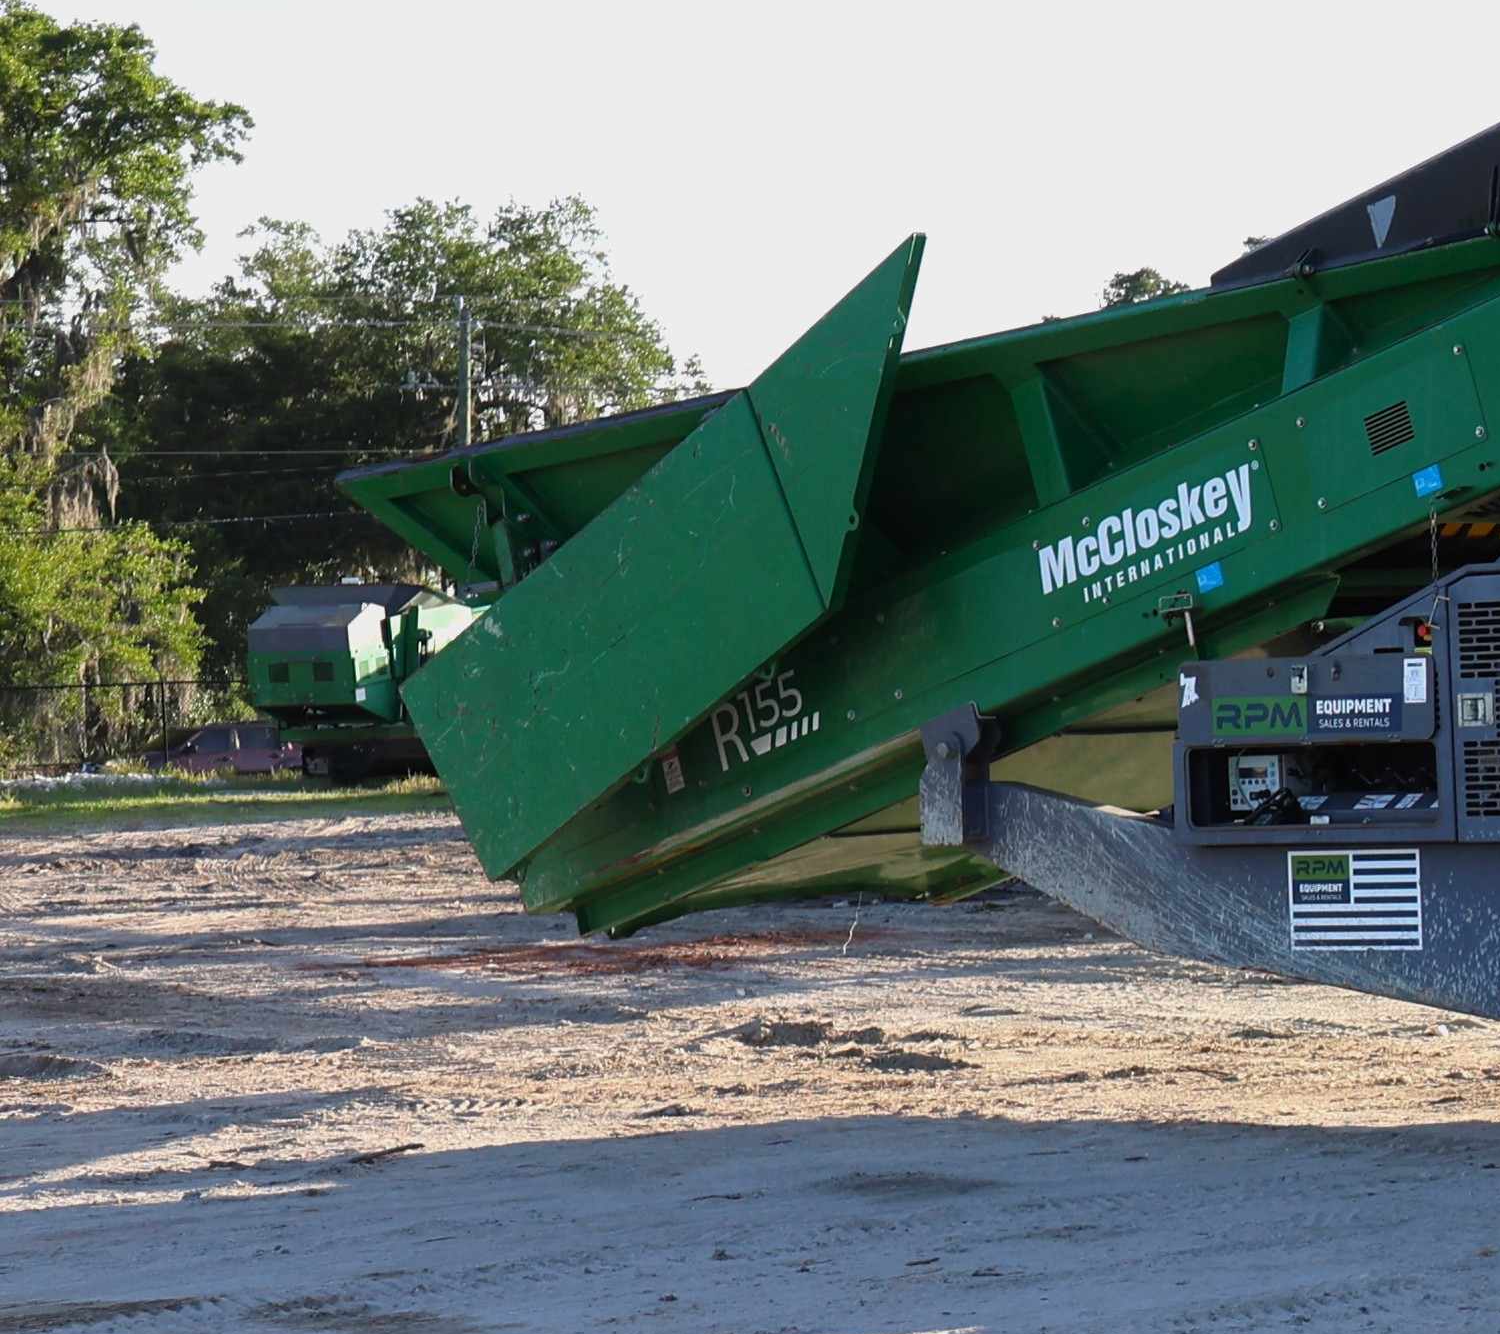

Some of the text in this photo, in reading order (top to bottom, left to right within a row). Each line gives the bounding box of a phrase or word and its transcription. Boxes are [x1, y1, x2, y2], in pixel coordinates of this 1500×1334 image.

[1038, 463, 1252, 595] McCloskey
[1083, 520, 1236, 603] INTERNATIONAL
[1215, 701, 1303, 731] RPM
[1315, 697, 1393, 715] EQUIPMENT
[711, 669, 803, 772] R155
[1318, 717, 1390, 729] SALES & RENTALS
[1296, 859, 1345, 876] RPM
[1299, 883, 1343, 893] EQUIPMENT
